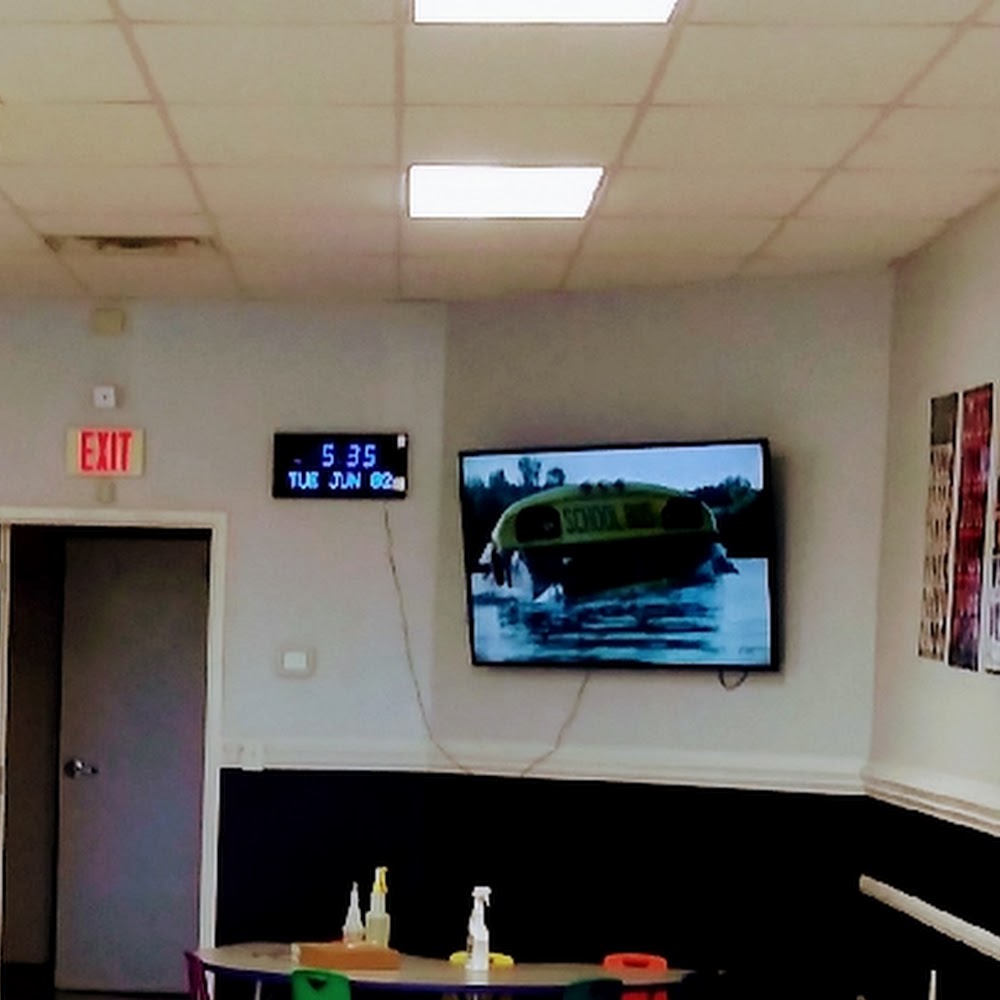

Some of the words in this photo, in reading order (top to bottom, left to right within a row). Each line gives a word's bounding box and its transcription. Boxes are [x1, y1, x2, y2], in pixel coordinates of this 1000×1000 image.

[81, 431, 132, 472] EXIT
[288, 471, 319, 489] TUE
[328, 471, 360, 489] JUN
[370, 471, 393, 489] 02
[562, 503, 622, 533] SCHOOL
